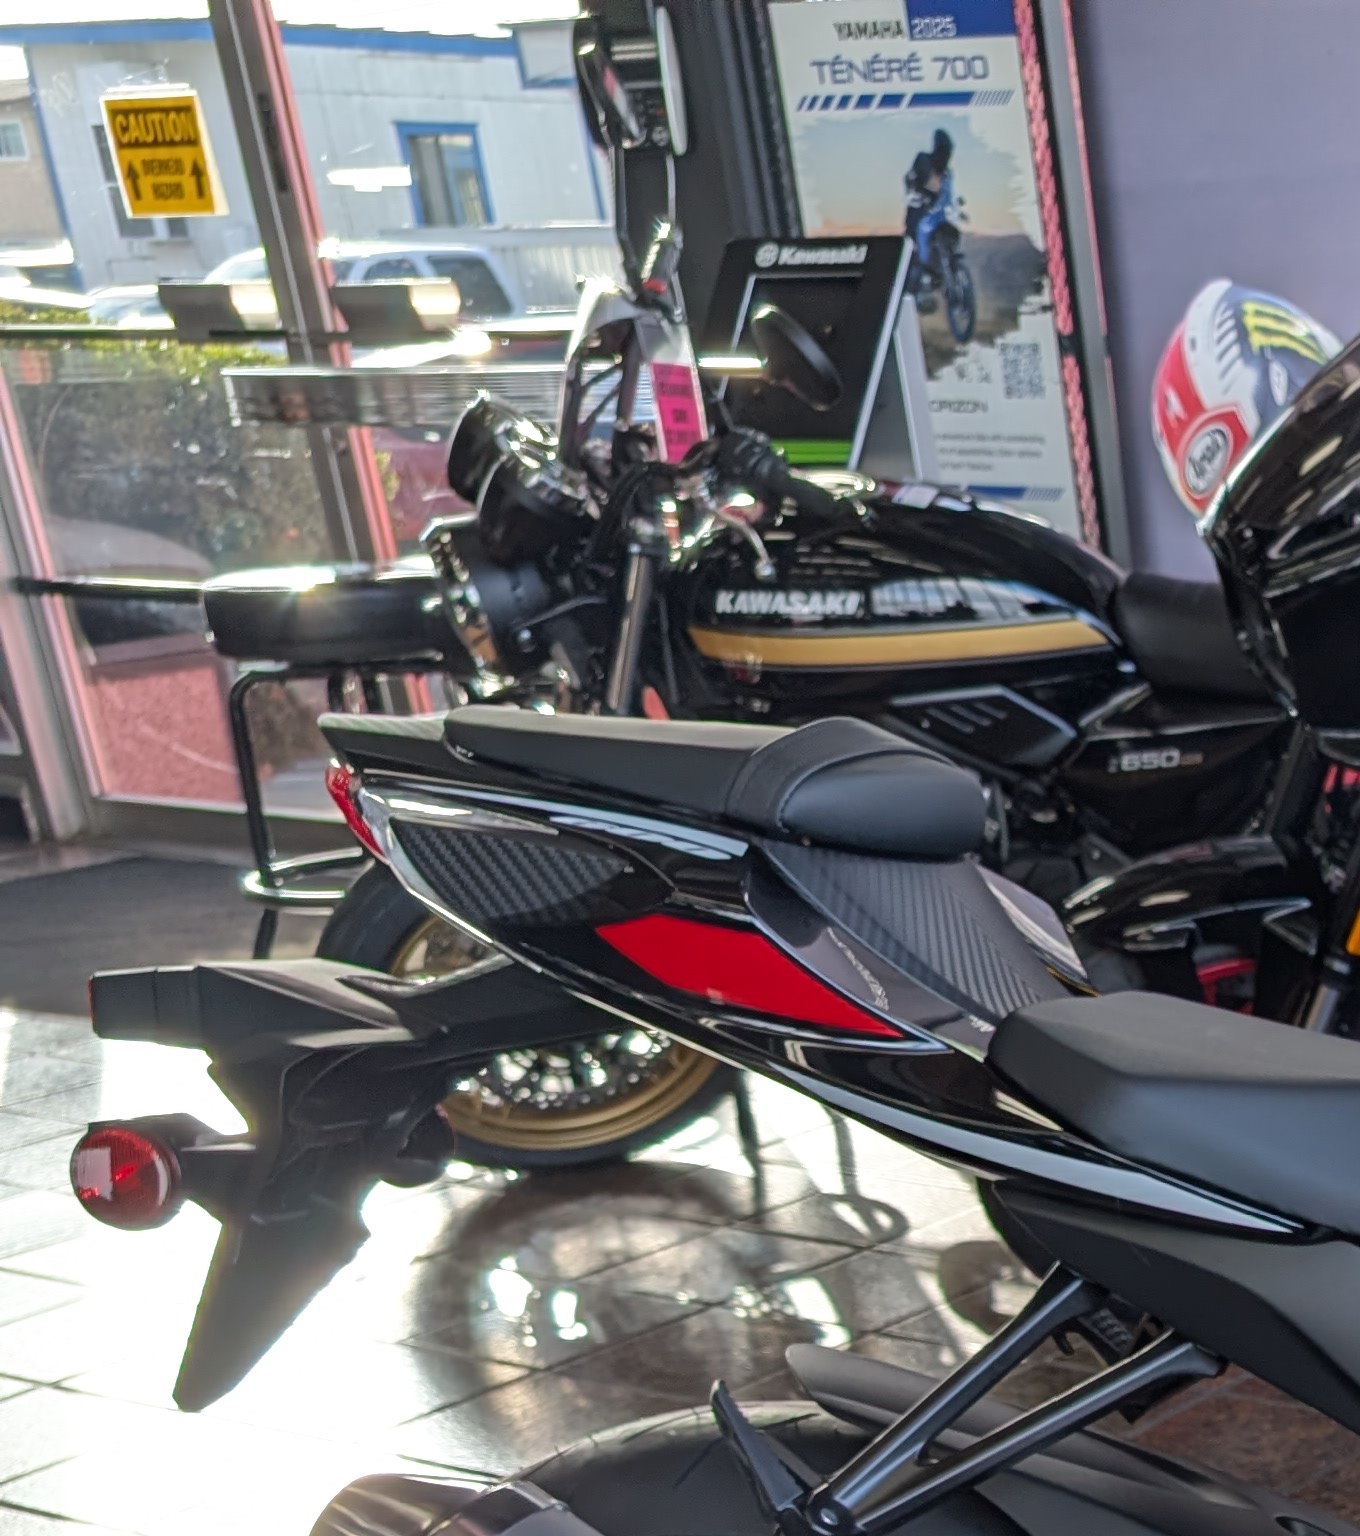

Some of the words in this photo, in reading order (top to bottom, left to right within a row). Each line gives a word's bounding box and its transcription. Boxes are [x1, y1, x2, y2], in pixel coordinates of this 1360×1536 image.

[911, 16, 958, 38] 2025
[810, 52, 925, 85] TÉNÉRÉ
[931, 55, 990, 81] 700
[114, 110, 196, 144] CAUTION
[715, 589, 863, 617] KAWASAKI
